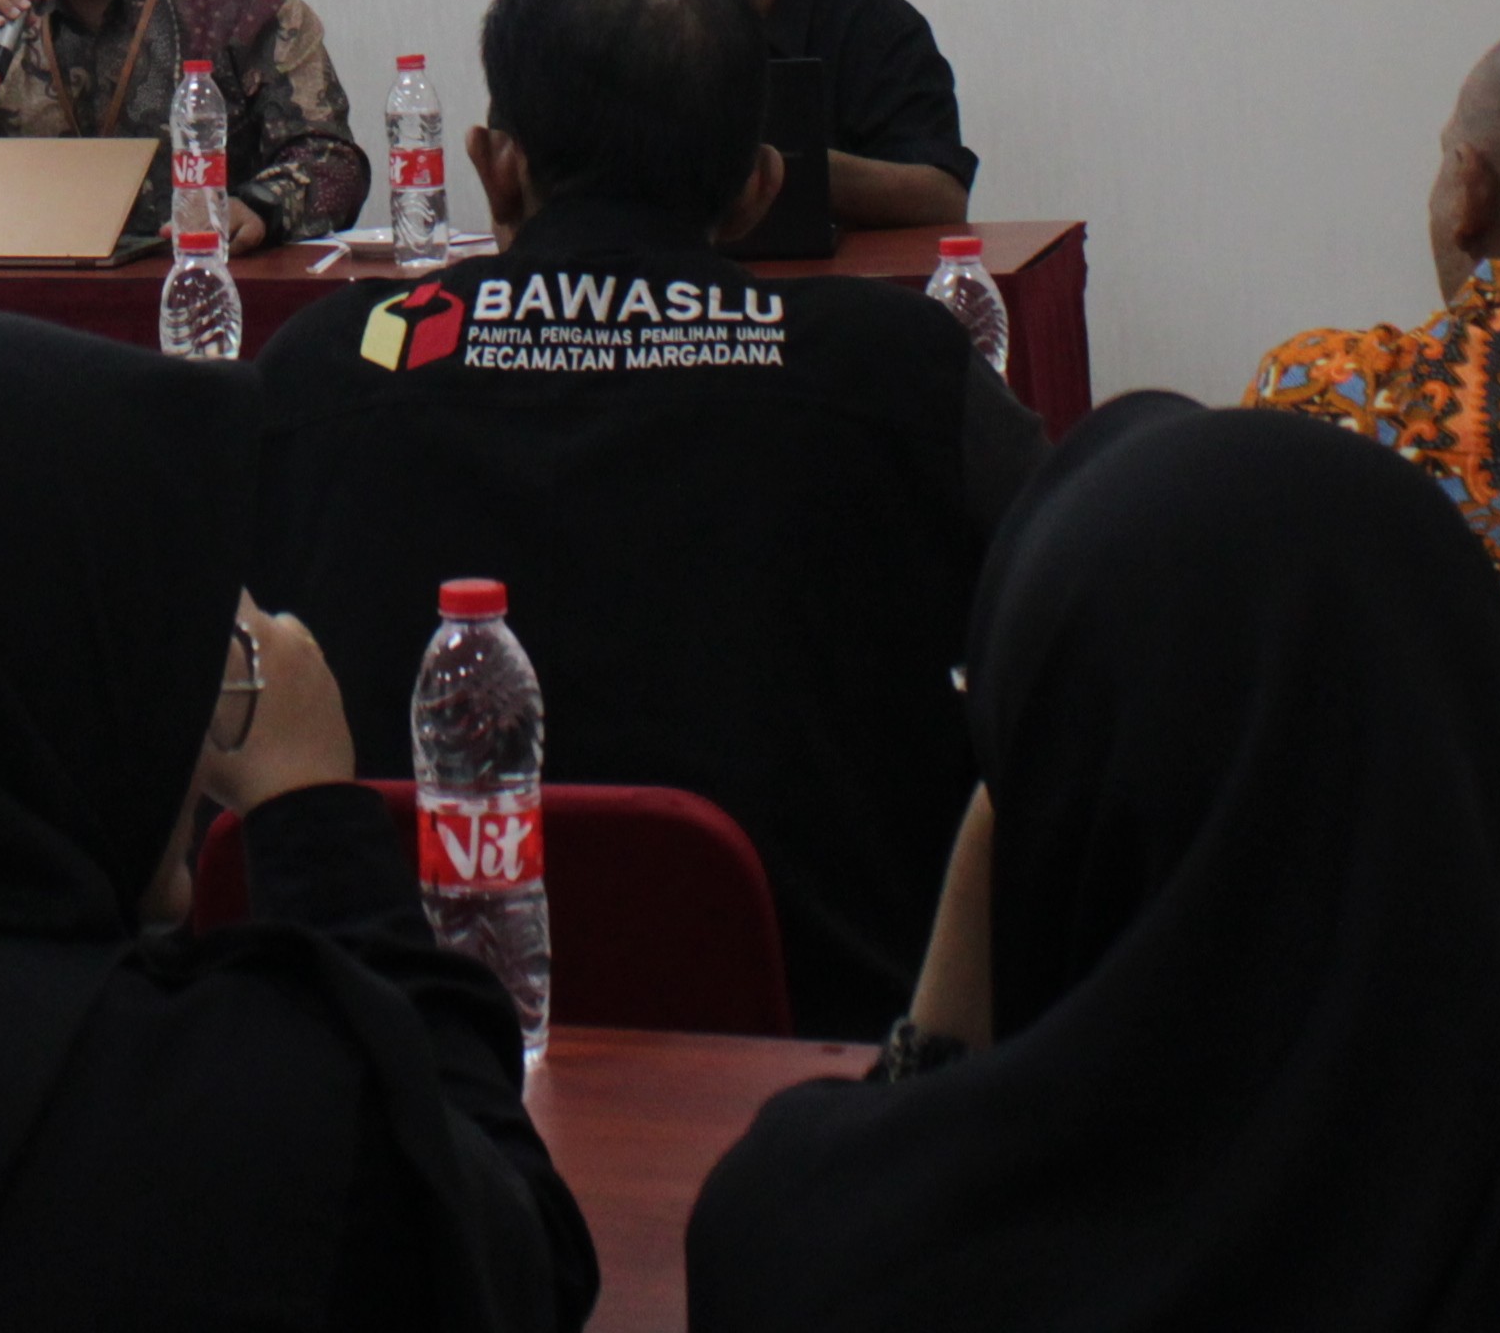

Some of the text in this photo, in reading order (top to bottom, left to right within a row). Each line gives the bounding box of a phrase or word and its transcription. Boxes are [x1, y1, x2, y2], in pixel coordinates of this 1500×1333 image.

[174, 155, 212, 185] Vit
[473, 272, 783, 323] BAWASLU
[468, 326, 785, 346] PANITIA PENGAWAS PEMILIHAN UMUM
[464, 344, 783, 370] KECAMATAN MARGADANA
[436, 807, 533, 881] Vit
